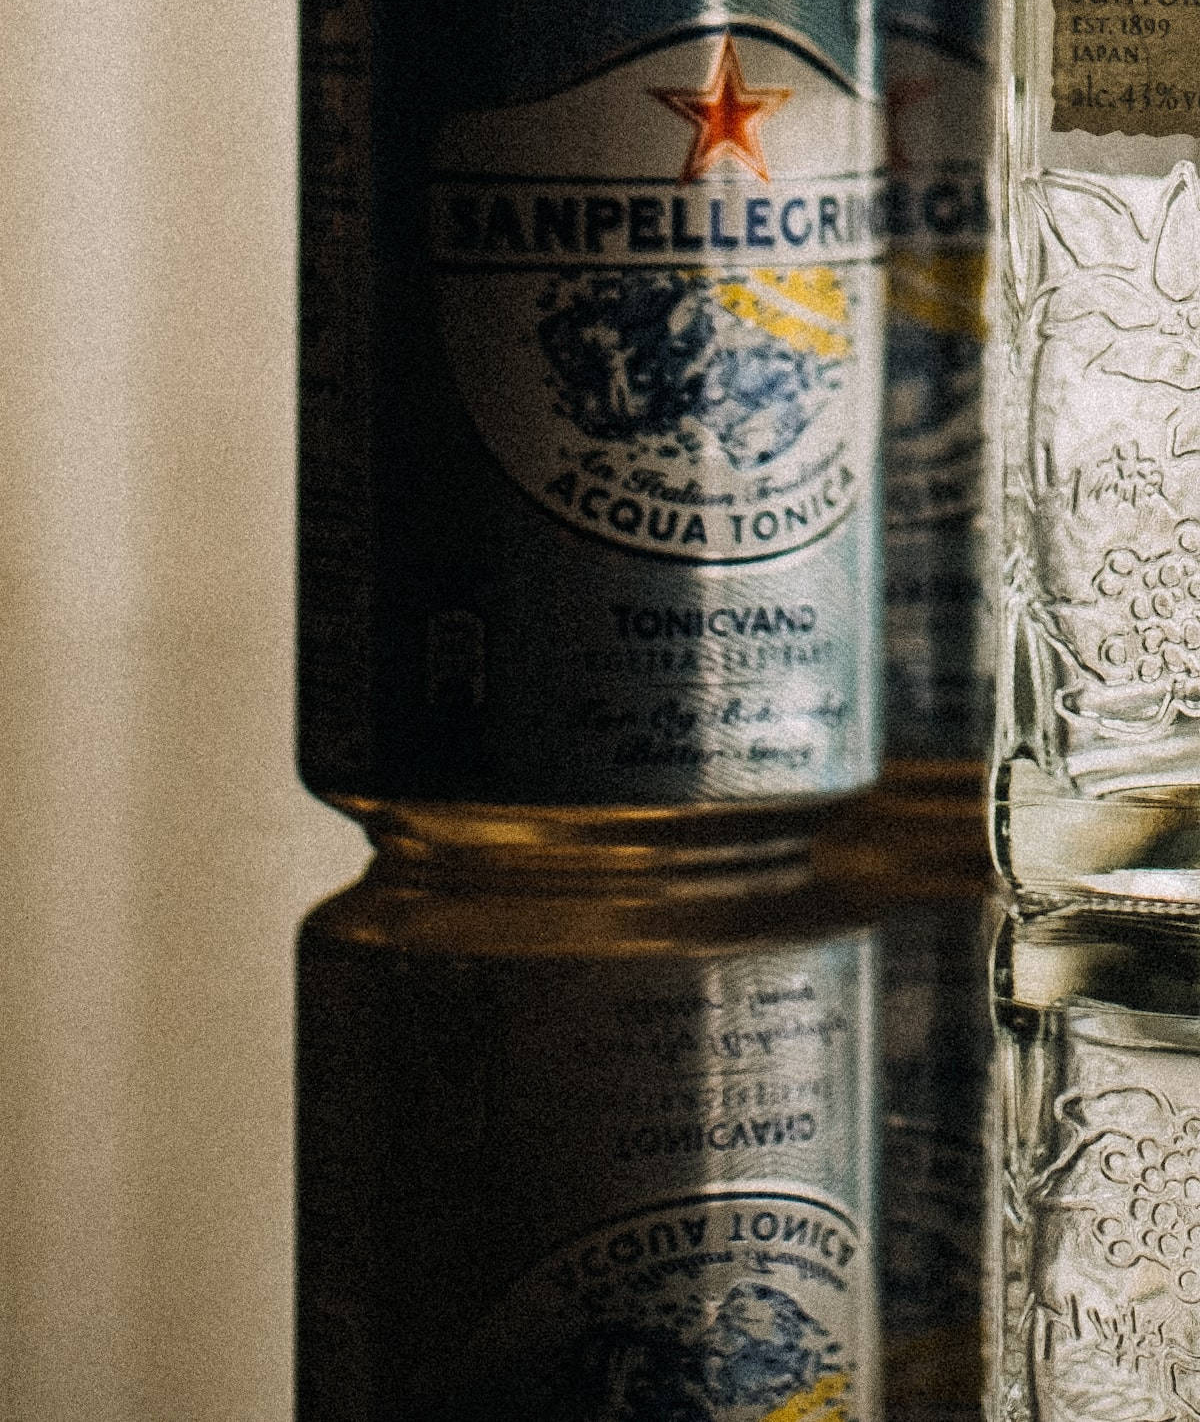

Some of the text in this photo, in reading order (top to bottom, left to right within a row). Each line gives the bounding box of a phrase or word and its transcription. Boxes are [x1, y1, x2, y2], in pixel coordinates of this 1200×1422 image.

[1118, 13, 1171, 40] 1899
[1073, 44, 1140, 64] JAPAN
[543, 470, 708, 545] ACQUA
[728, 465, 856, 545] TONICA
